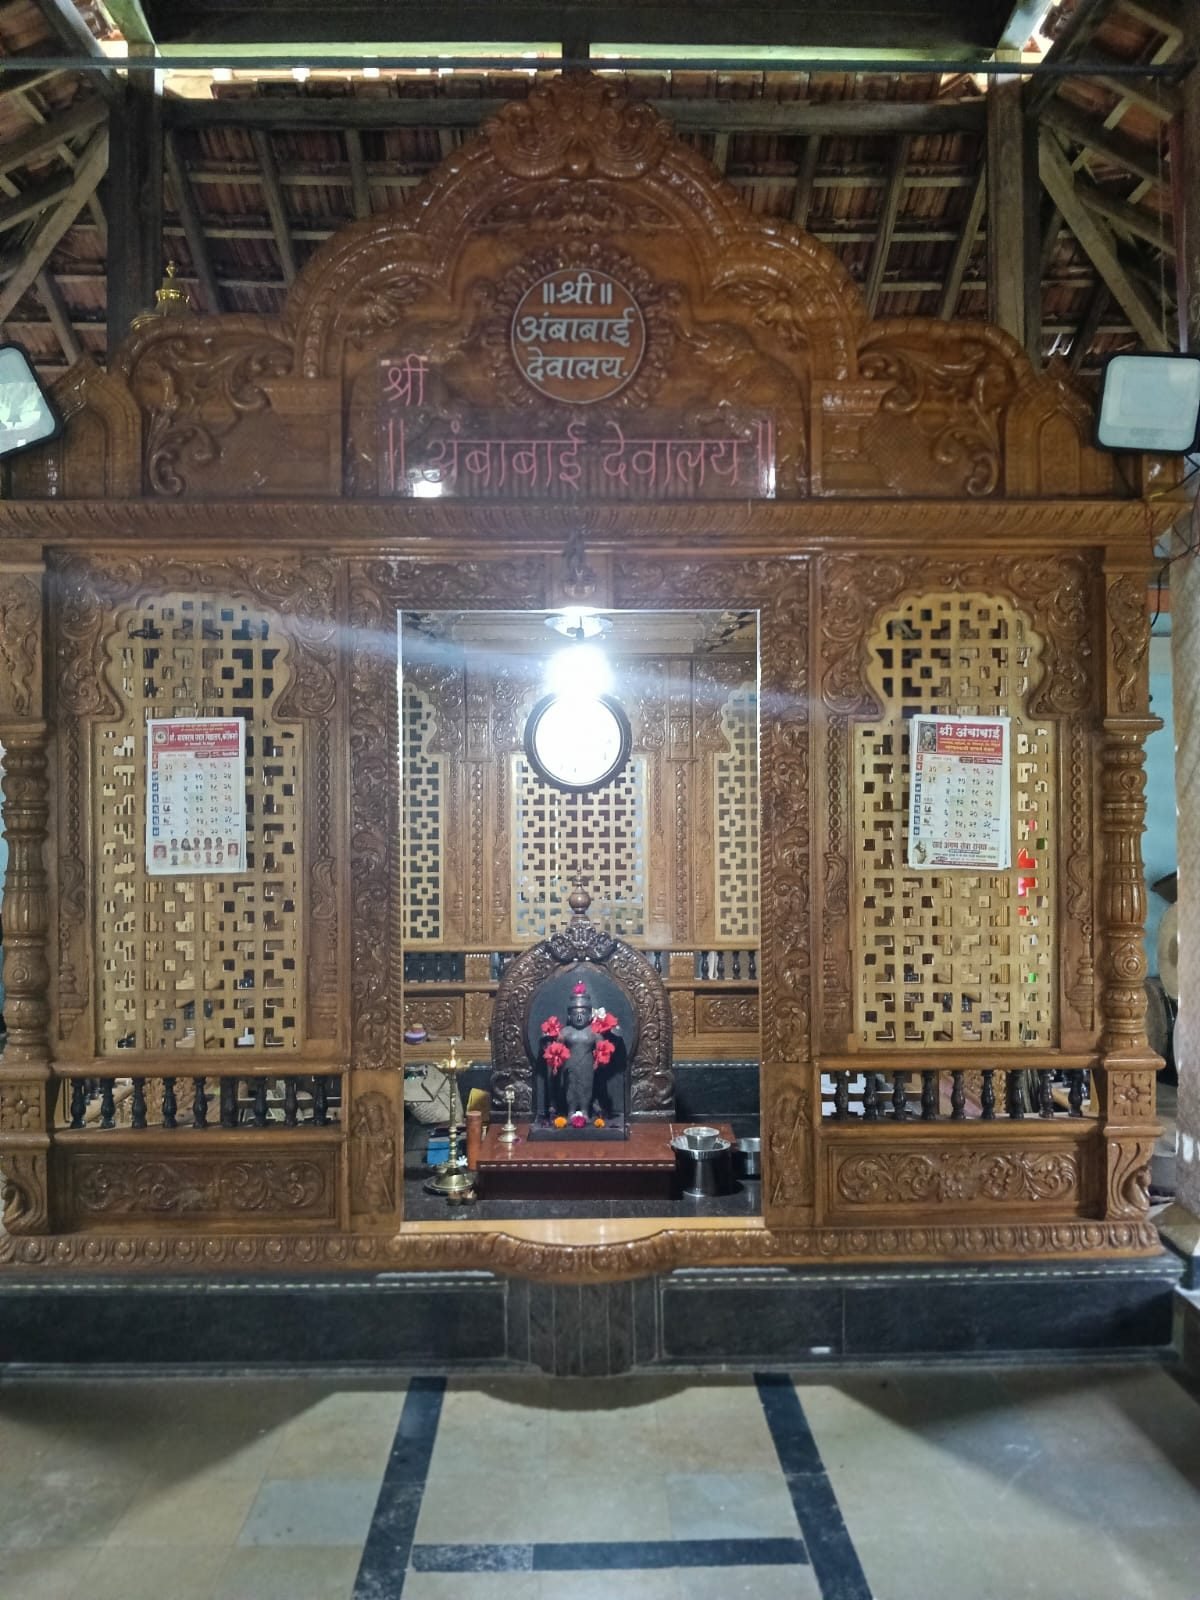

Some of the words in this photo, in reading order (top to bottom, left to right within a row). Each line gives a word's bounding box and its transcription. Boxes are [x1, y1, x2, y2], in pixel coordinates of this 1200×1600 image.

[516, 307, 635, 347] अंबाबाई
[383, 353, 428, 406] श्री
[422, 421, 588, 491] अंबाबाई
[601, 421, 749, 488] देवालय
[939, 724, 953, 738] श्री
